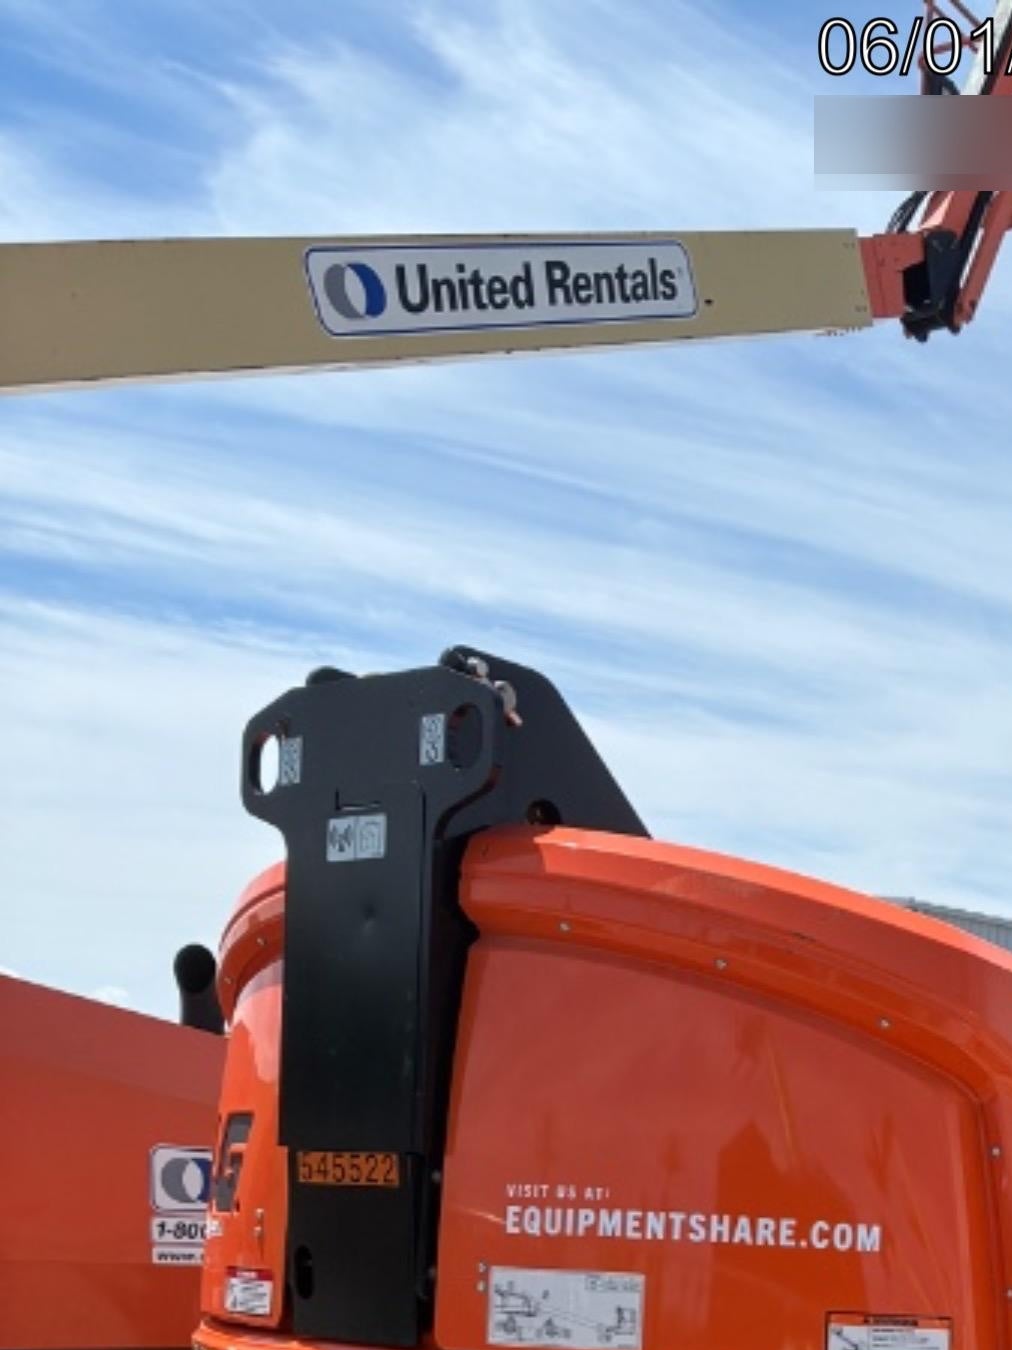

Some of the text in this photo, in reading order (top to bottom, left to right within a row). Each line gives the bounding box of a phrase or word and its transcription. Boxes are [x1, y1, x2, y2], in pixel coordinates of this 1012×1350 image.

[395, 257, 679, 314] United Rentals
[299, 1152, 398, 1183] 545522
[505, 1184, 549, 1199] VISIT
[505, 1205, 881, 1252] EQUIPMENTSHARE.COM
